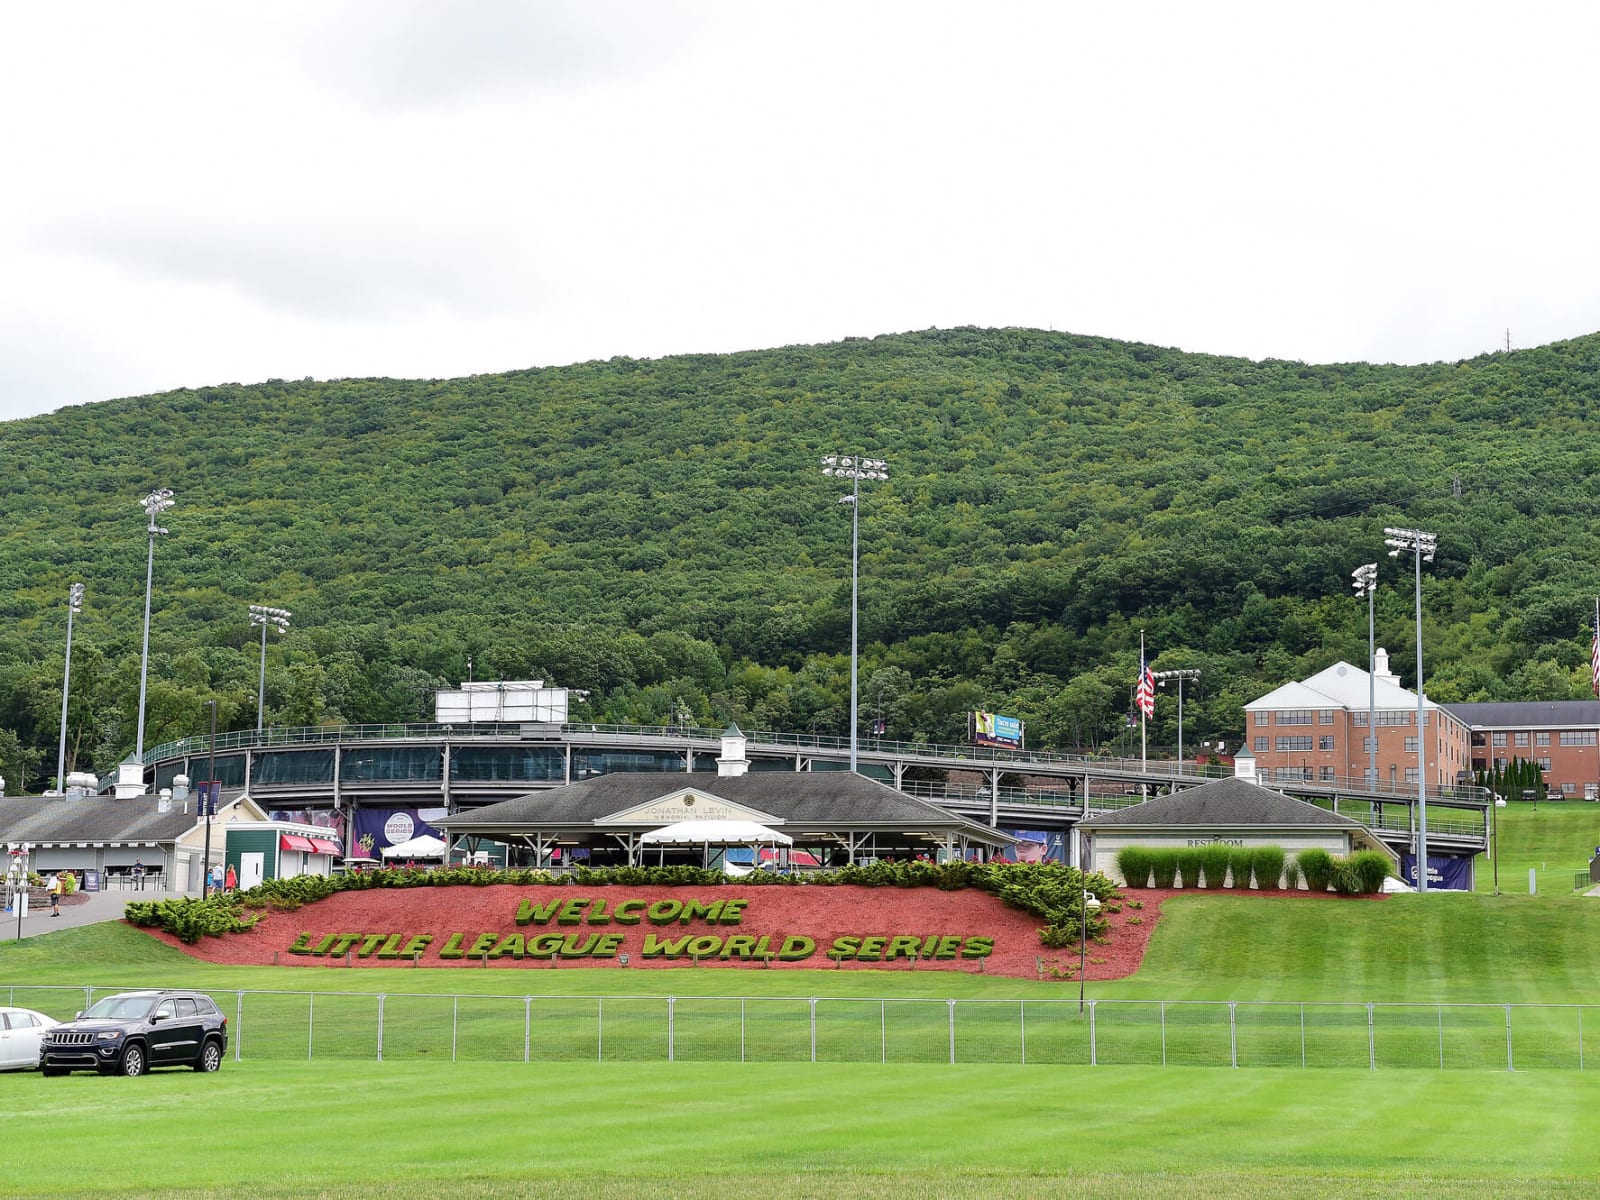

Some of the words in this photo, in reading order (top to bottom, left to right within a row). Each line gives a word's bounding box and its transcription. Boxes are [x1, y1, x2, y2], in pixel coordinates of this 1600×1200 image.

[515, 898, 749, 926] WELCOME
[288, 931, 433, 959] LITTLE
[439, 932, 624, 960] LEAGUE
[642, 934, 817, 961] WORLD
[828, 935, 994, 961] SERIES
